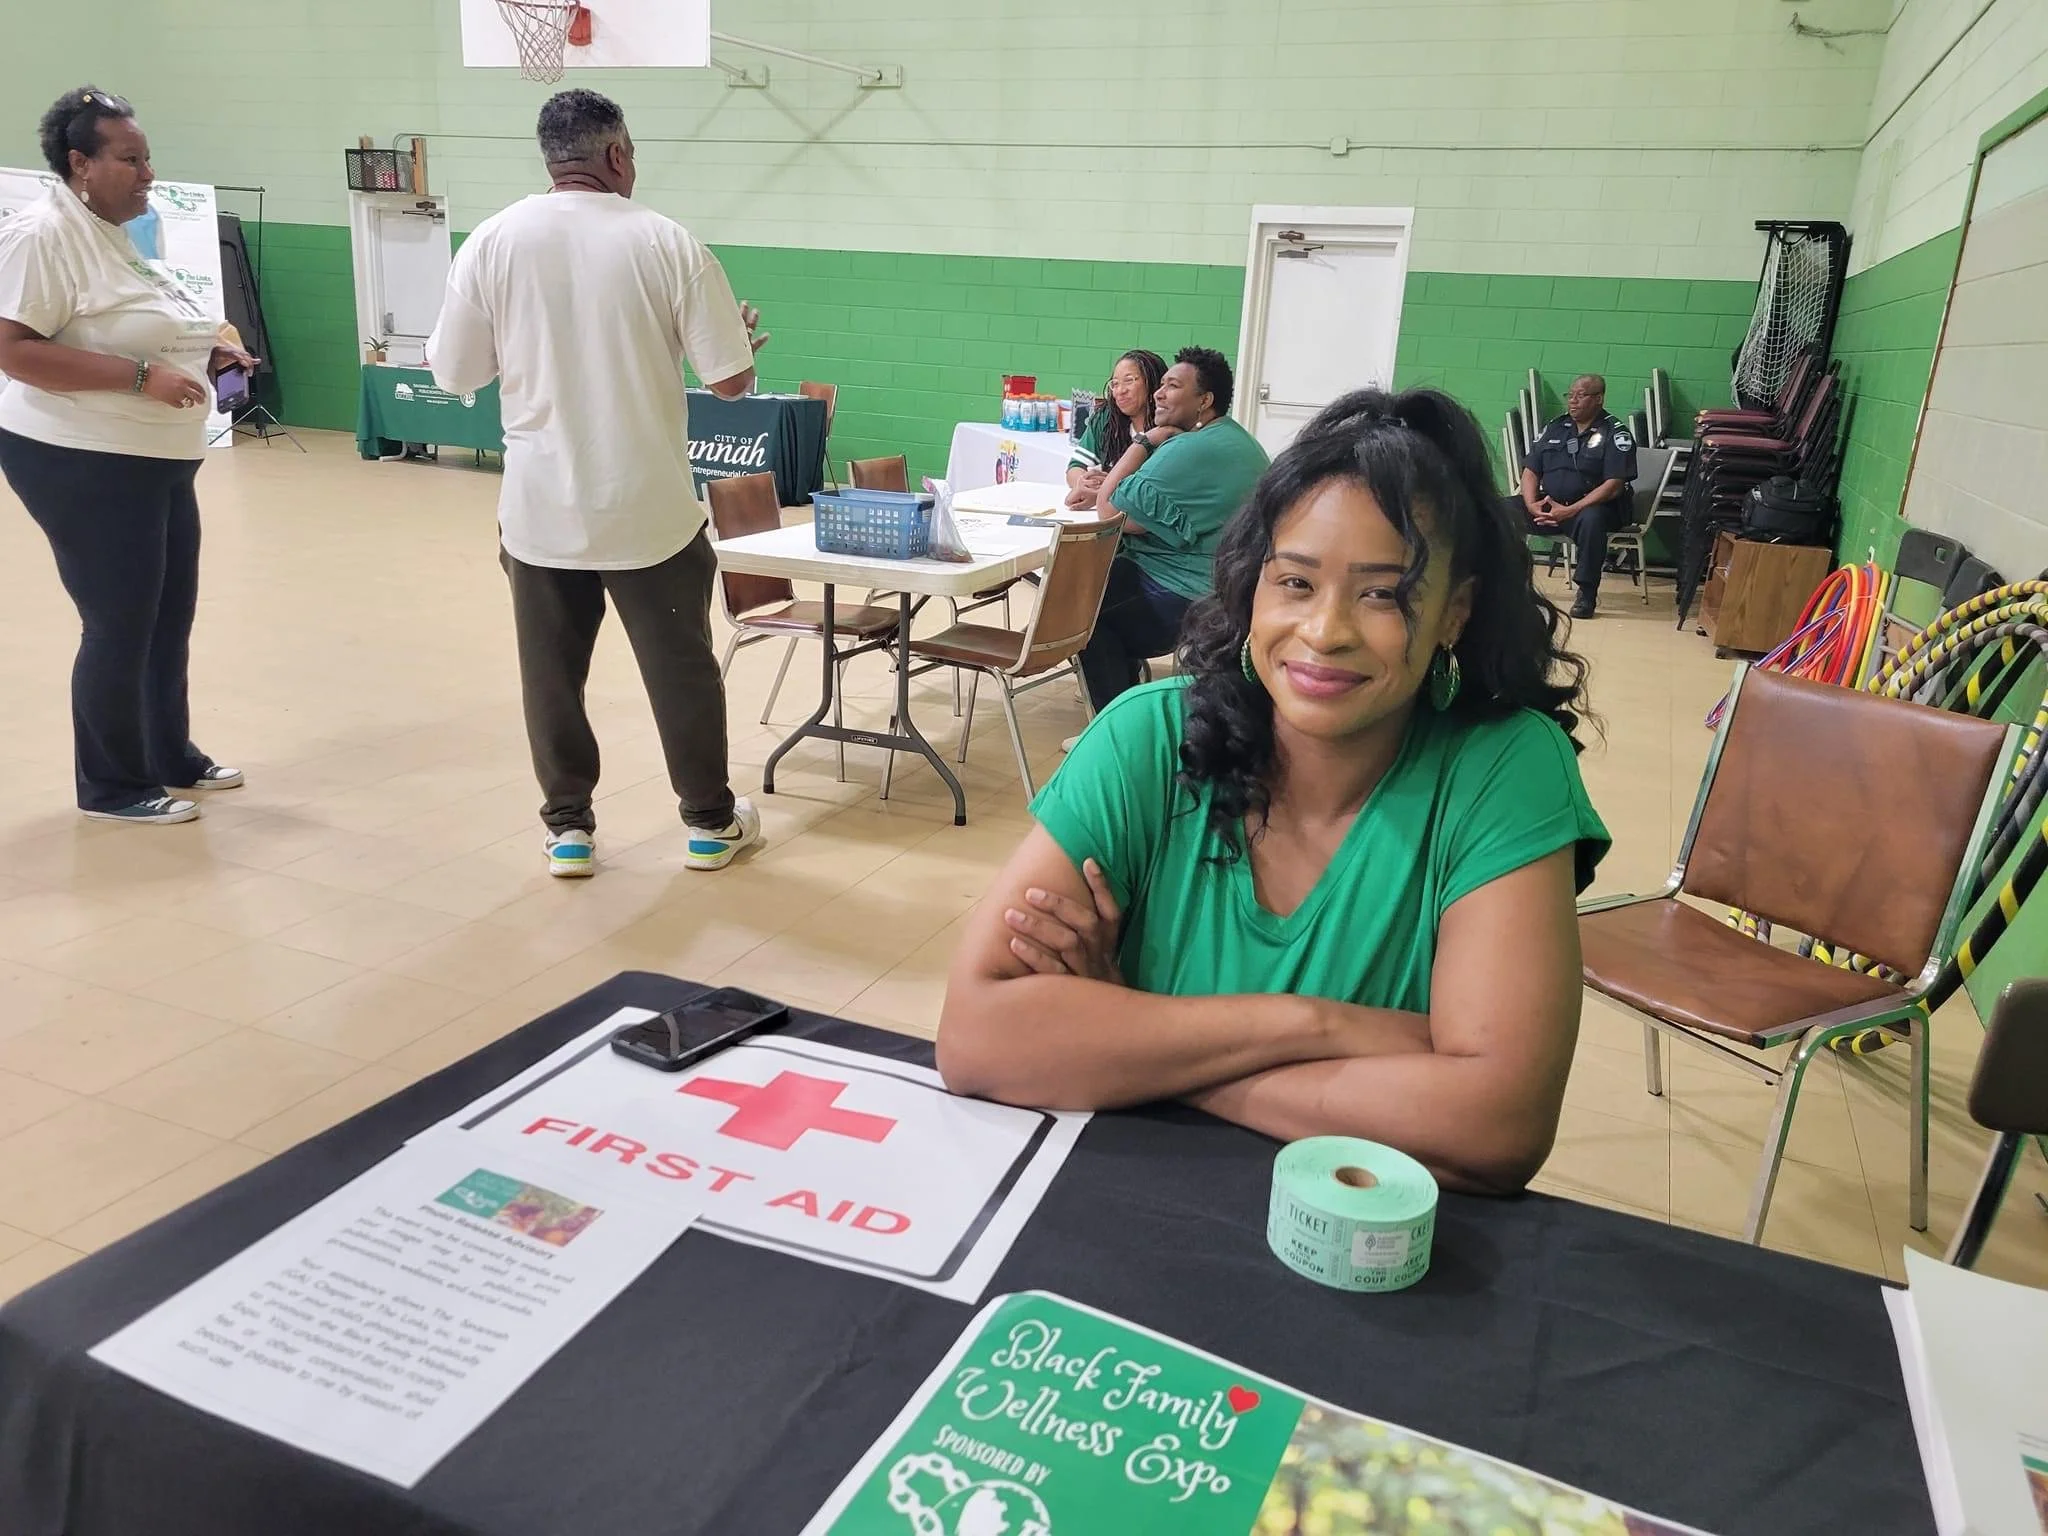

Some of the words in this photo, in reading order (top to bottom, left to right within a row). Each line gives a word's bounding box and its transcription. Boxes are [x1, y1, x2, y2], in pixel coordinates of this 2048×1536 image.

[714, 434, 737, 444] CITY
[740, 436, 754, 445] OF
[521, 1116, 756, 1193] FIRST
[765, 1189, 912, 1235] AID
[417, 1204, 454, 1221] Photo
[454, 1217, 501, 1239] Release
[501, 1235, 556, 1260] Advisory
[1289, 1203, 1328, 1235] TICKET
[1284, 1247, 1324, 1273] COUPON
[1291, 1238, 1317, 1256] KEEP
[1354, 1275, 1387, 1284] COUP
[990, 1319, 1118, 1391] Black
[1102, 1359, 1239, 1450] Family
[932, 1424, 1025, 1476] SPONSORED
[1023, 1462, 1052, 1486] BY
[955, 1367, 1123, 1456] Wellness
[1124, 1434, 1232, 1502] Expo
